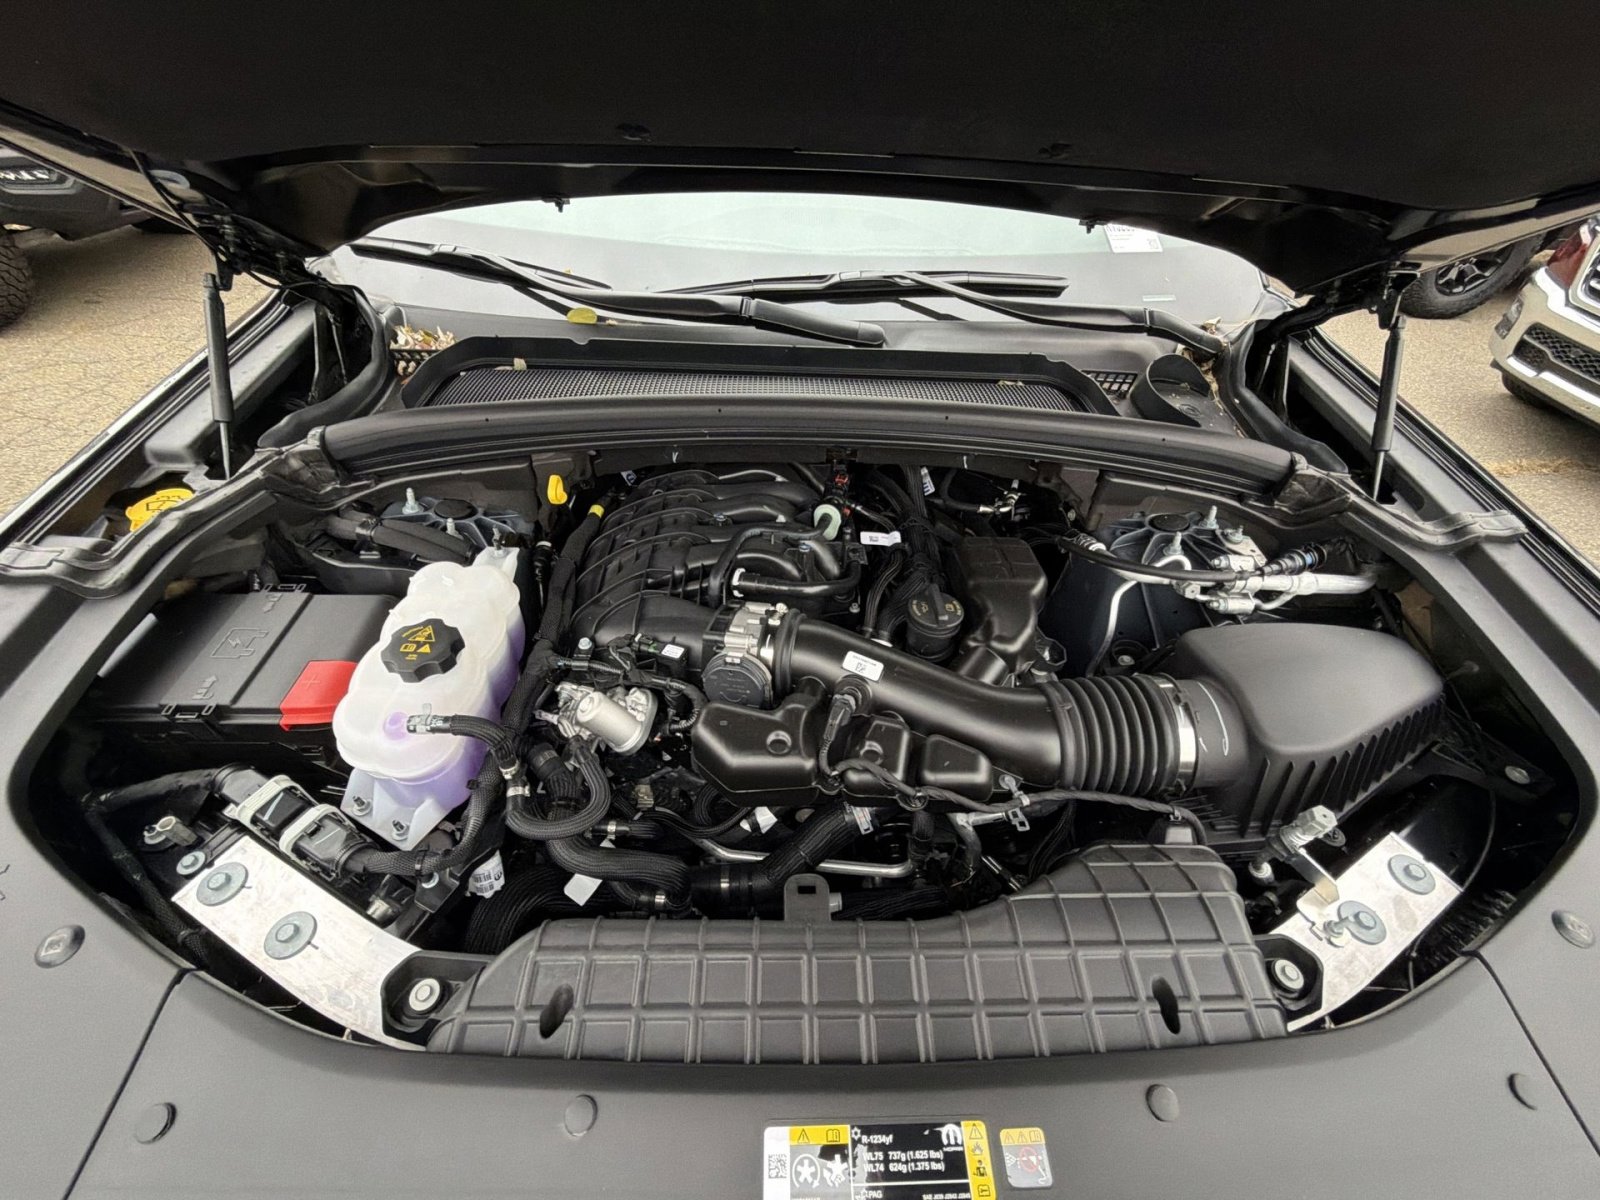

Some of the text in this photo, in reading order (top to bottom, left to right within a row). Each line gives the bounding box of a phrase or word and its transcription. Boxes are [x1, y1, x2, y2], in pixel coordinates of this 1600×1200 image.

[888, 1151, 906, 1162] 737g
[907, 1150, 929, 1161] (1.625
[929, 1149, 944, 1161] lbs)
[888, 1162, 907, 1174] 624g
[908, 1161, 930, 1173] (1.375
[930, 1161, 945, 1173] lbs)
